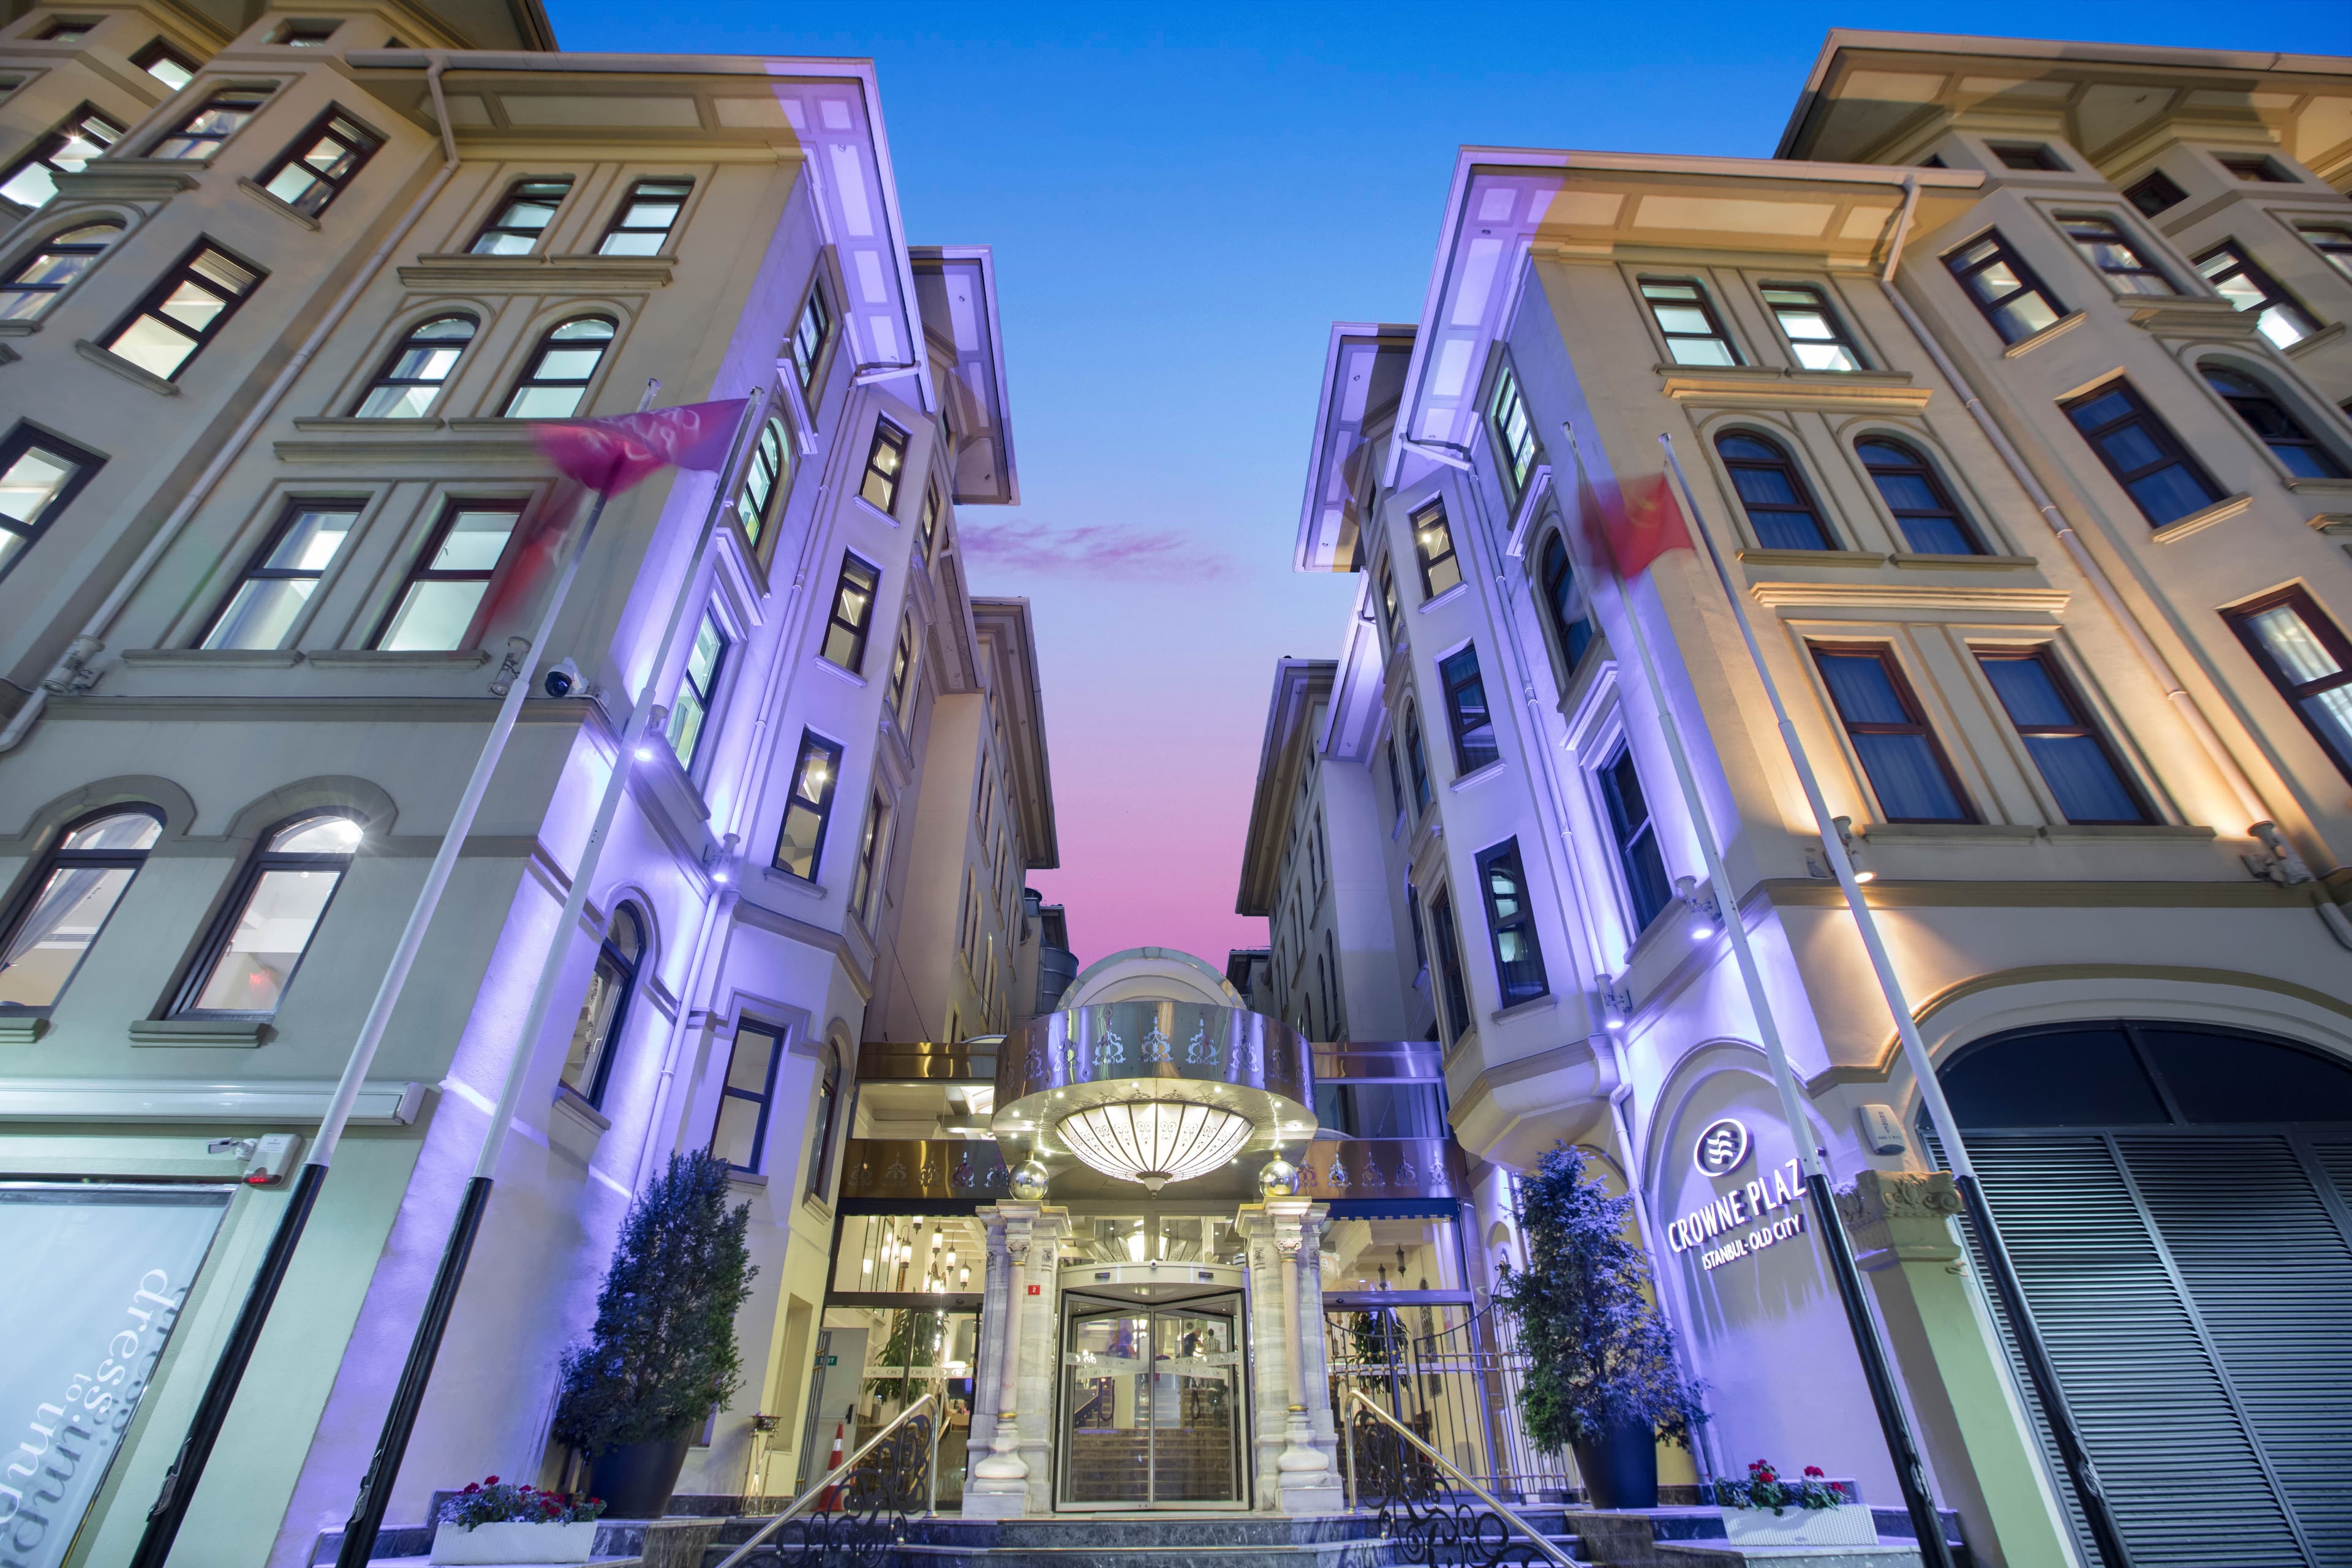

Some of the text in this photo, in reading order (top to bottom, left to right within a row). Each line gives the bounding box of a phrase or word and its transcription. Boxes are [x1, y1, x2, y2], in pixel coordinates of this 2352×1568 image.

[1668, 1158, 1807, 1253] CROWNE PLAZ
[1773, 1214, 1800, 1240] CITY
[66, 1373, 92, 1401] to
[0, 1402, 80, 1539] imp
